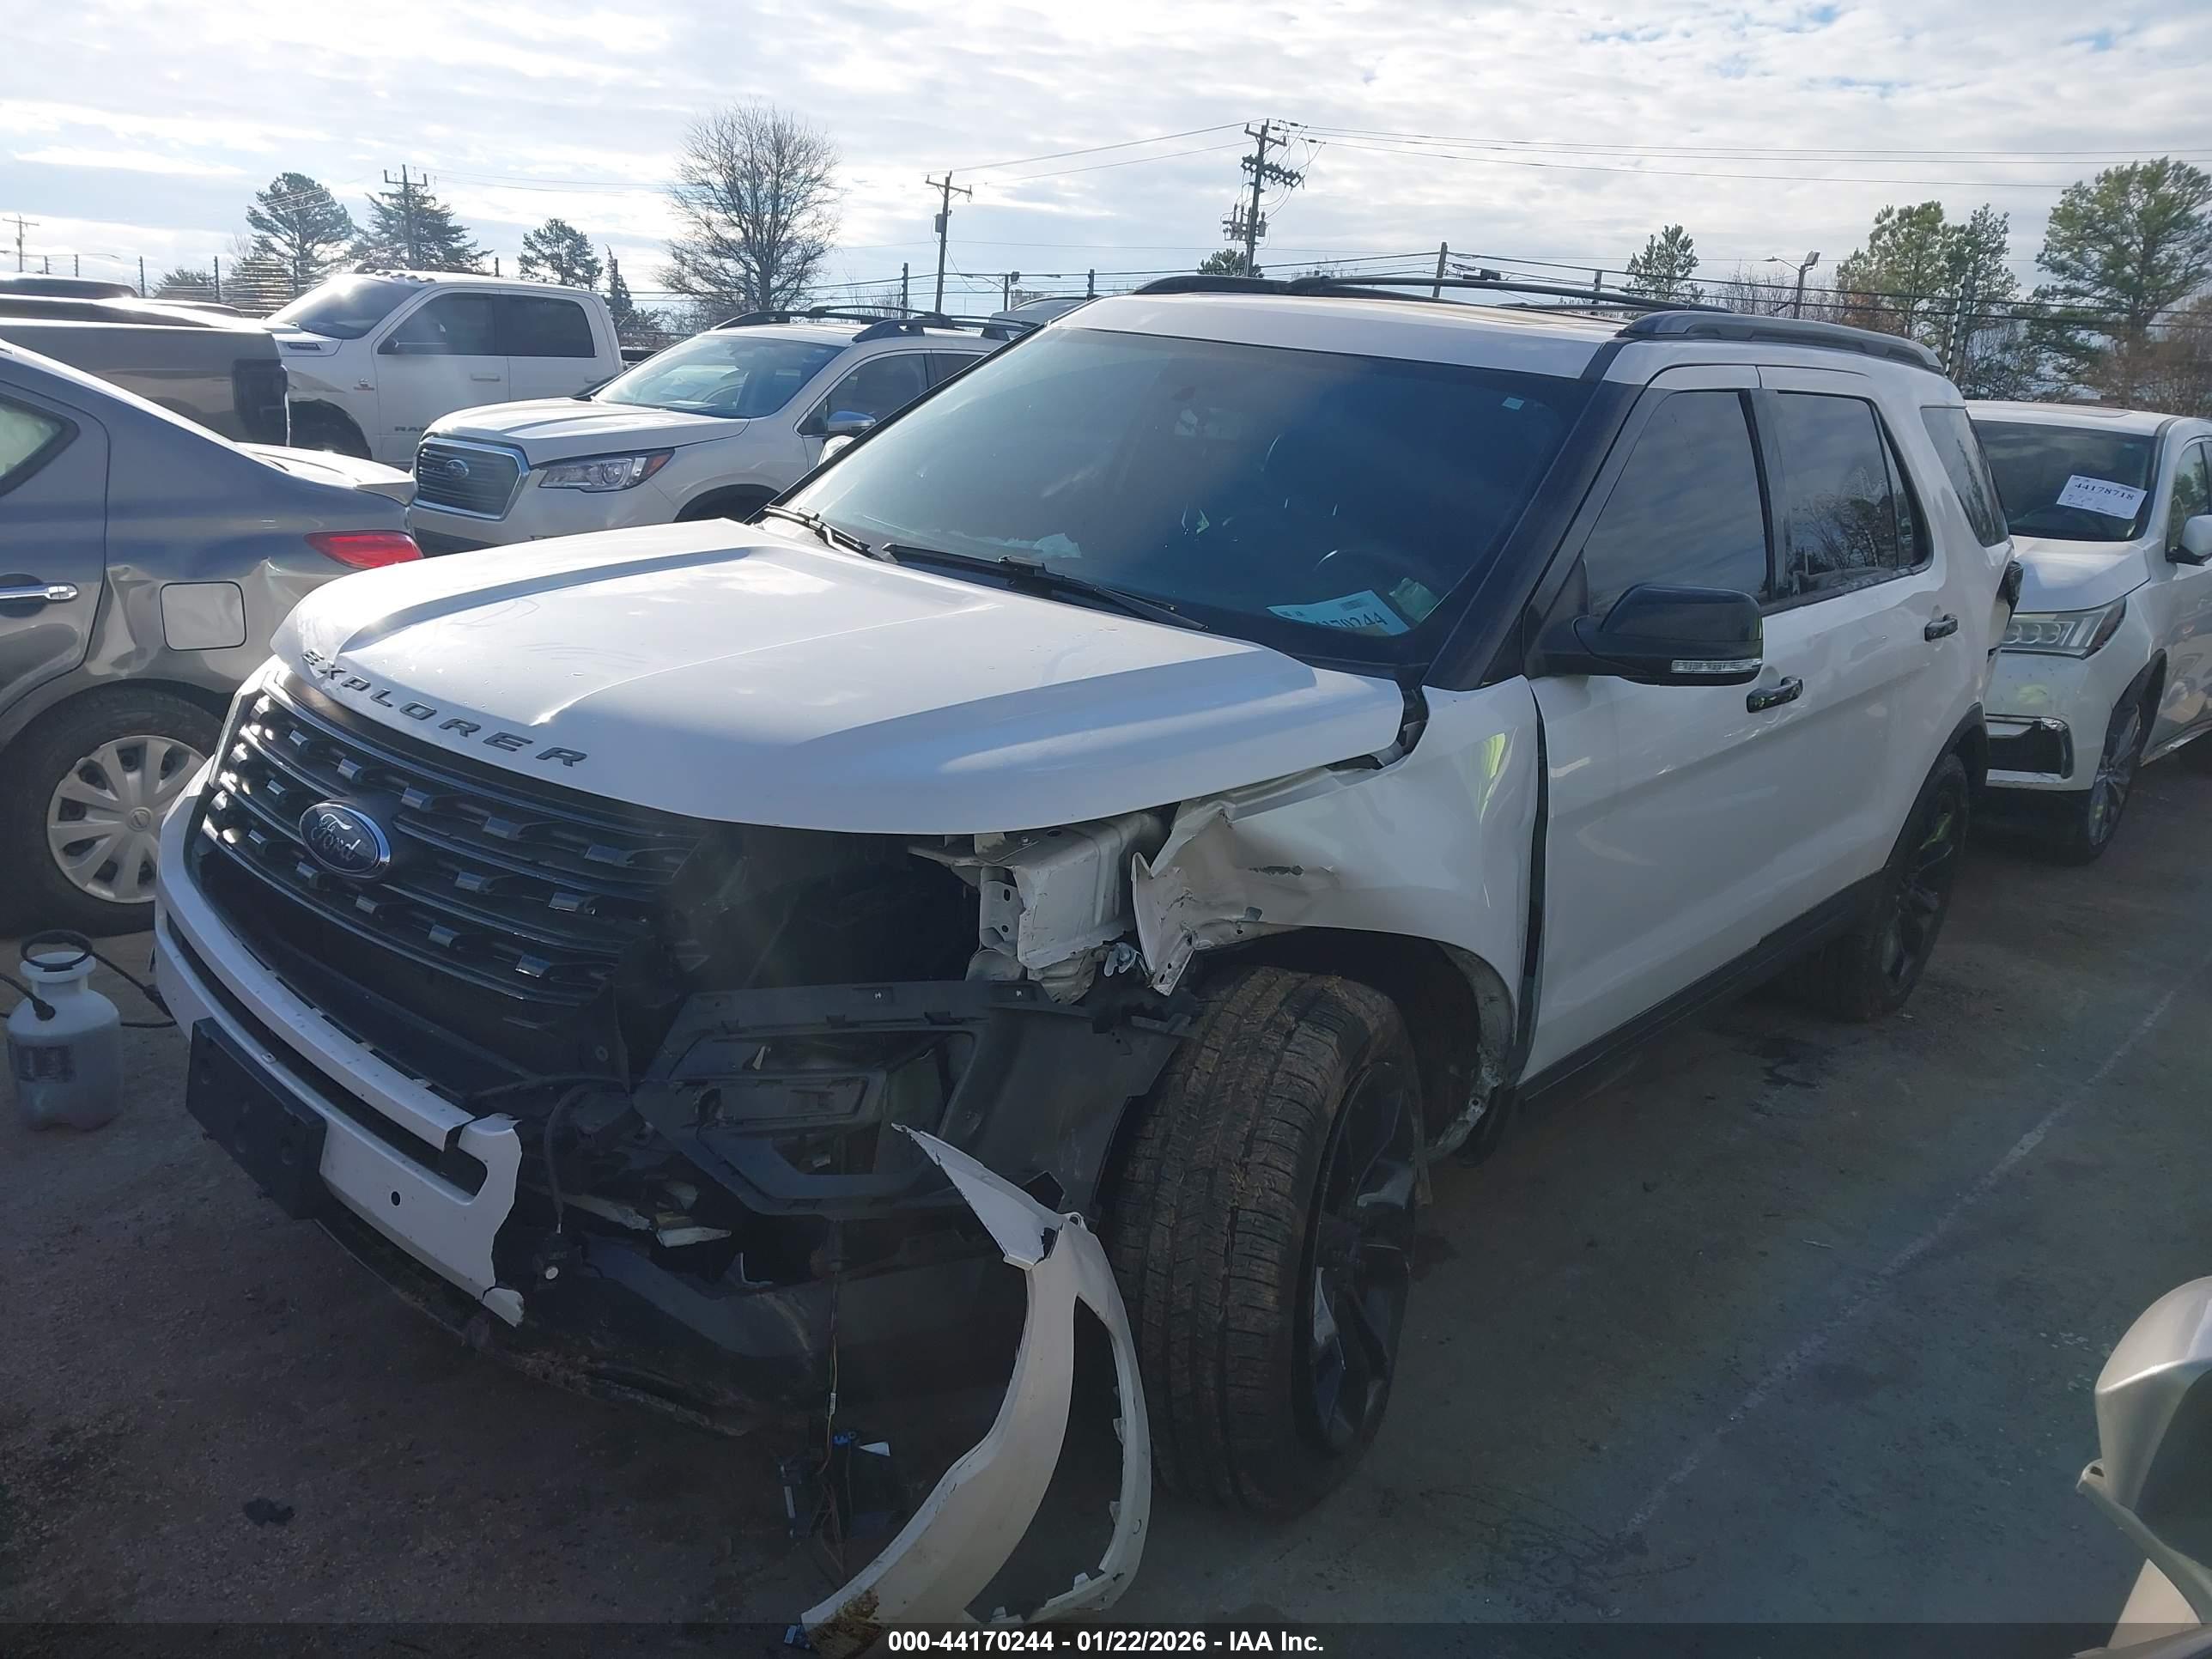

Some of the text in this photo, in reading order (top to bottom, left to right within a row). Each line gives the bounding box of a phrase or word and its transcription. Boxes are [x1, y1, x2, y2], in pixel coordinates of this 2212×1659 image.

[2075, 483, 2136, 501] 44178718
[1316, 611, 1389, 627] 70244
[302, 648, 589, 768] EXPLORER
[310, 812, 362, 862] Ford
